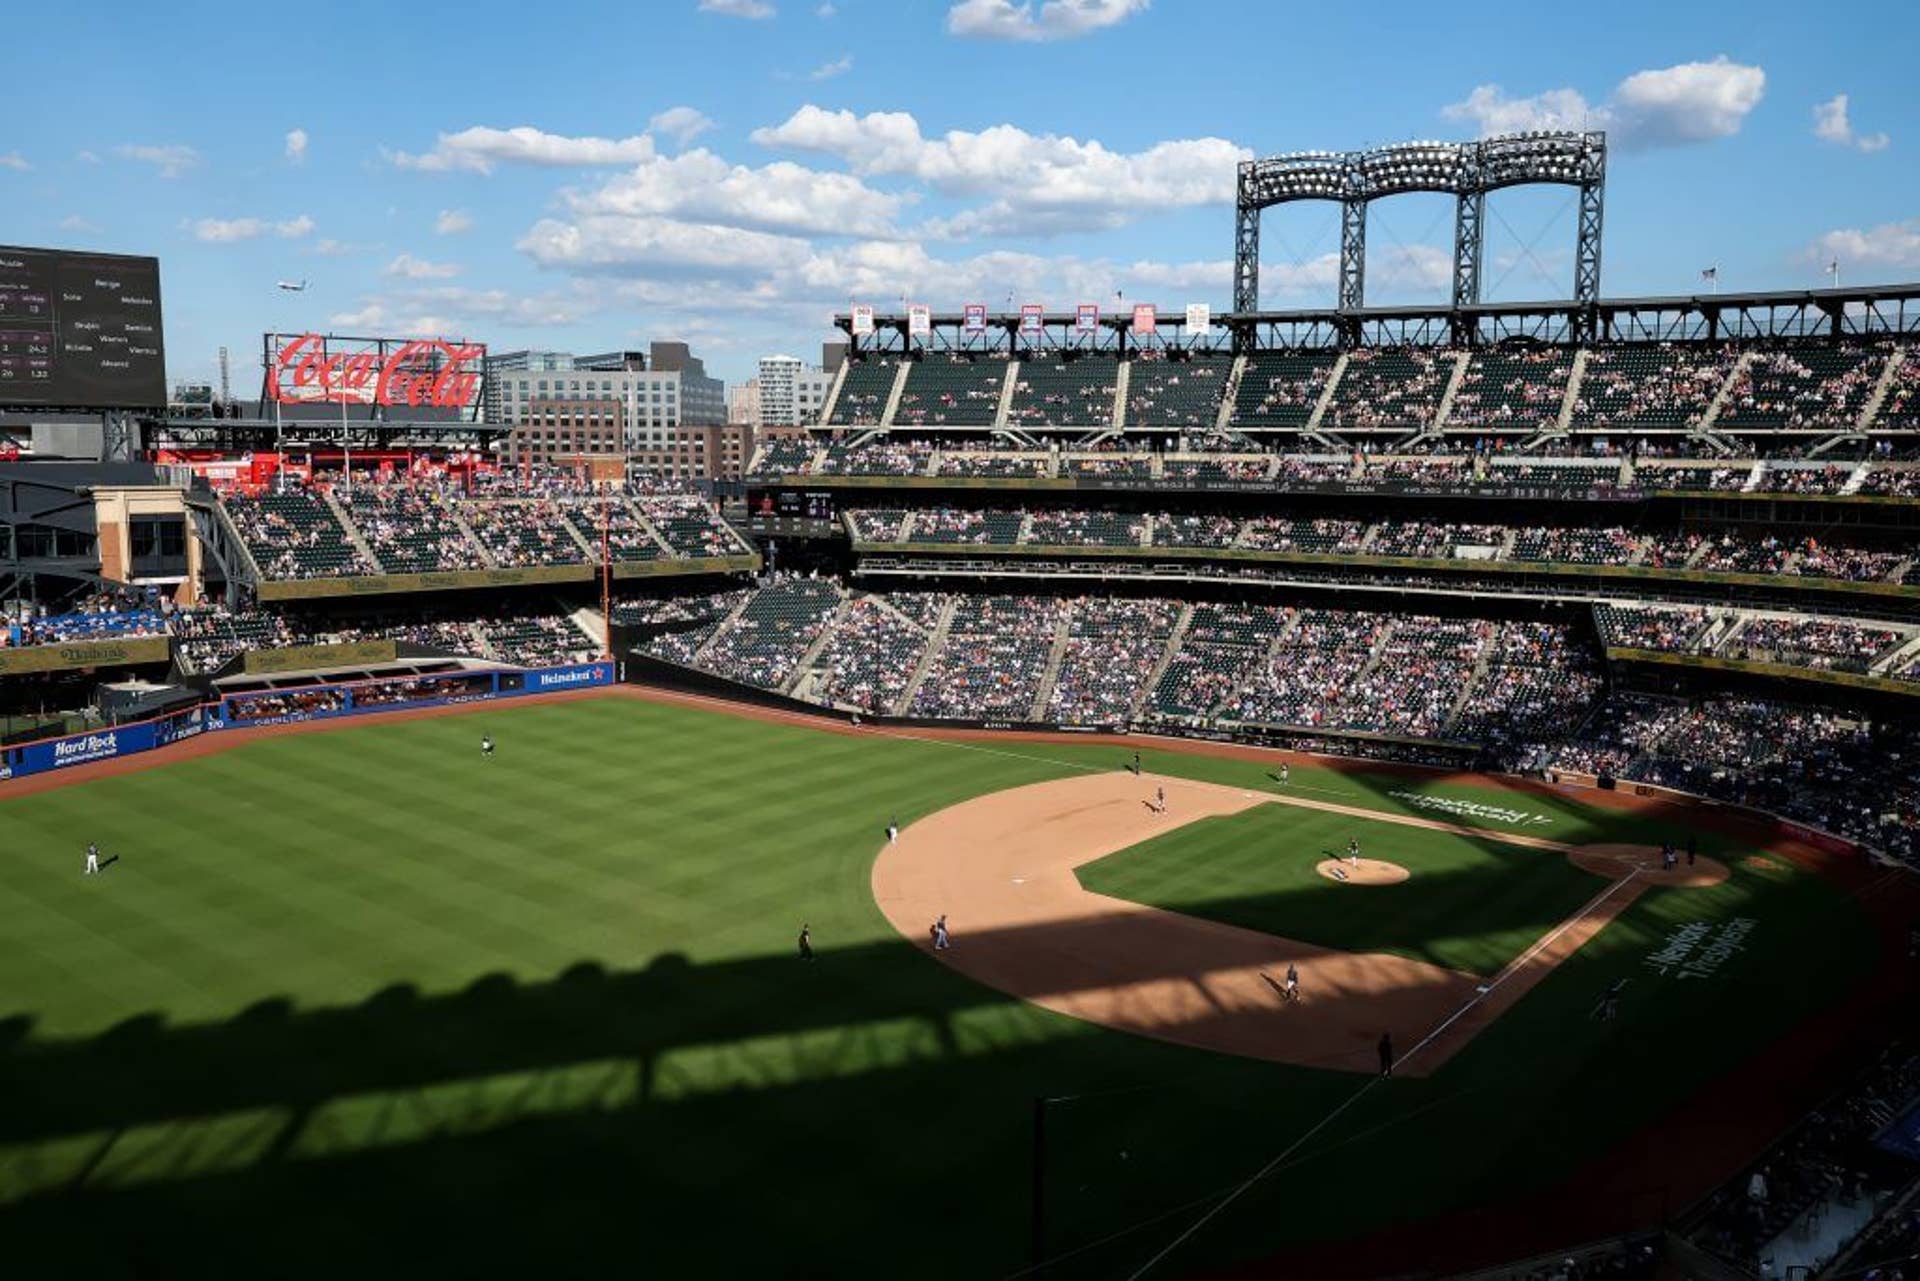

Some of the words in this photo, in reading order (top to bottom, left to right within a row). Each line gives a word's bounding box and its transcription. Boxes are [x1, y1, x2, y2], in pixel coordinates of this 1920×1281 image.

[540, 669, 591, 686] Heineken
[55, 737, 87, 757] Hard
[88, 732, 117, 751] Rock
